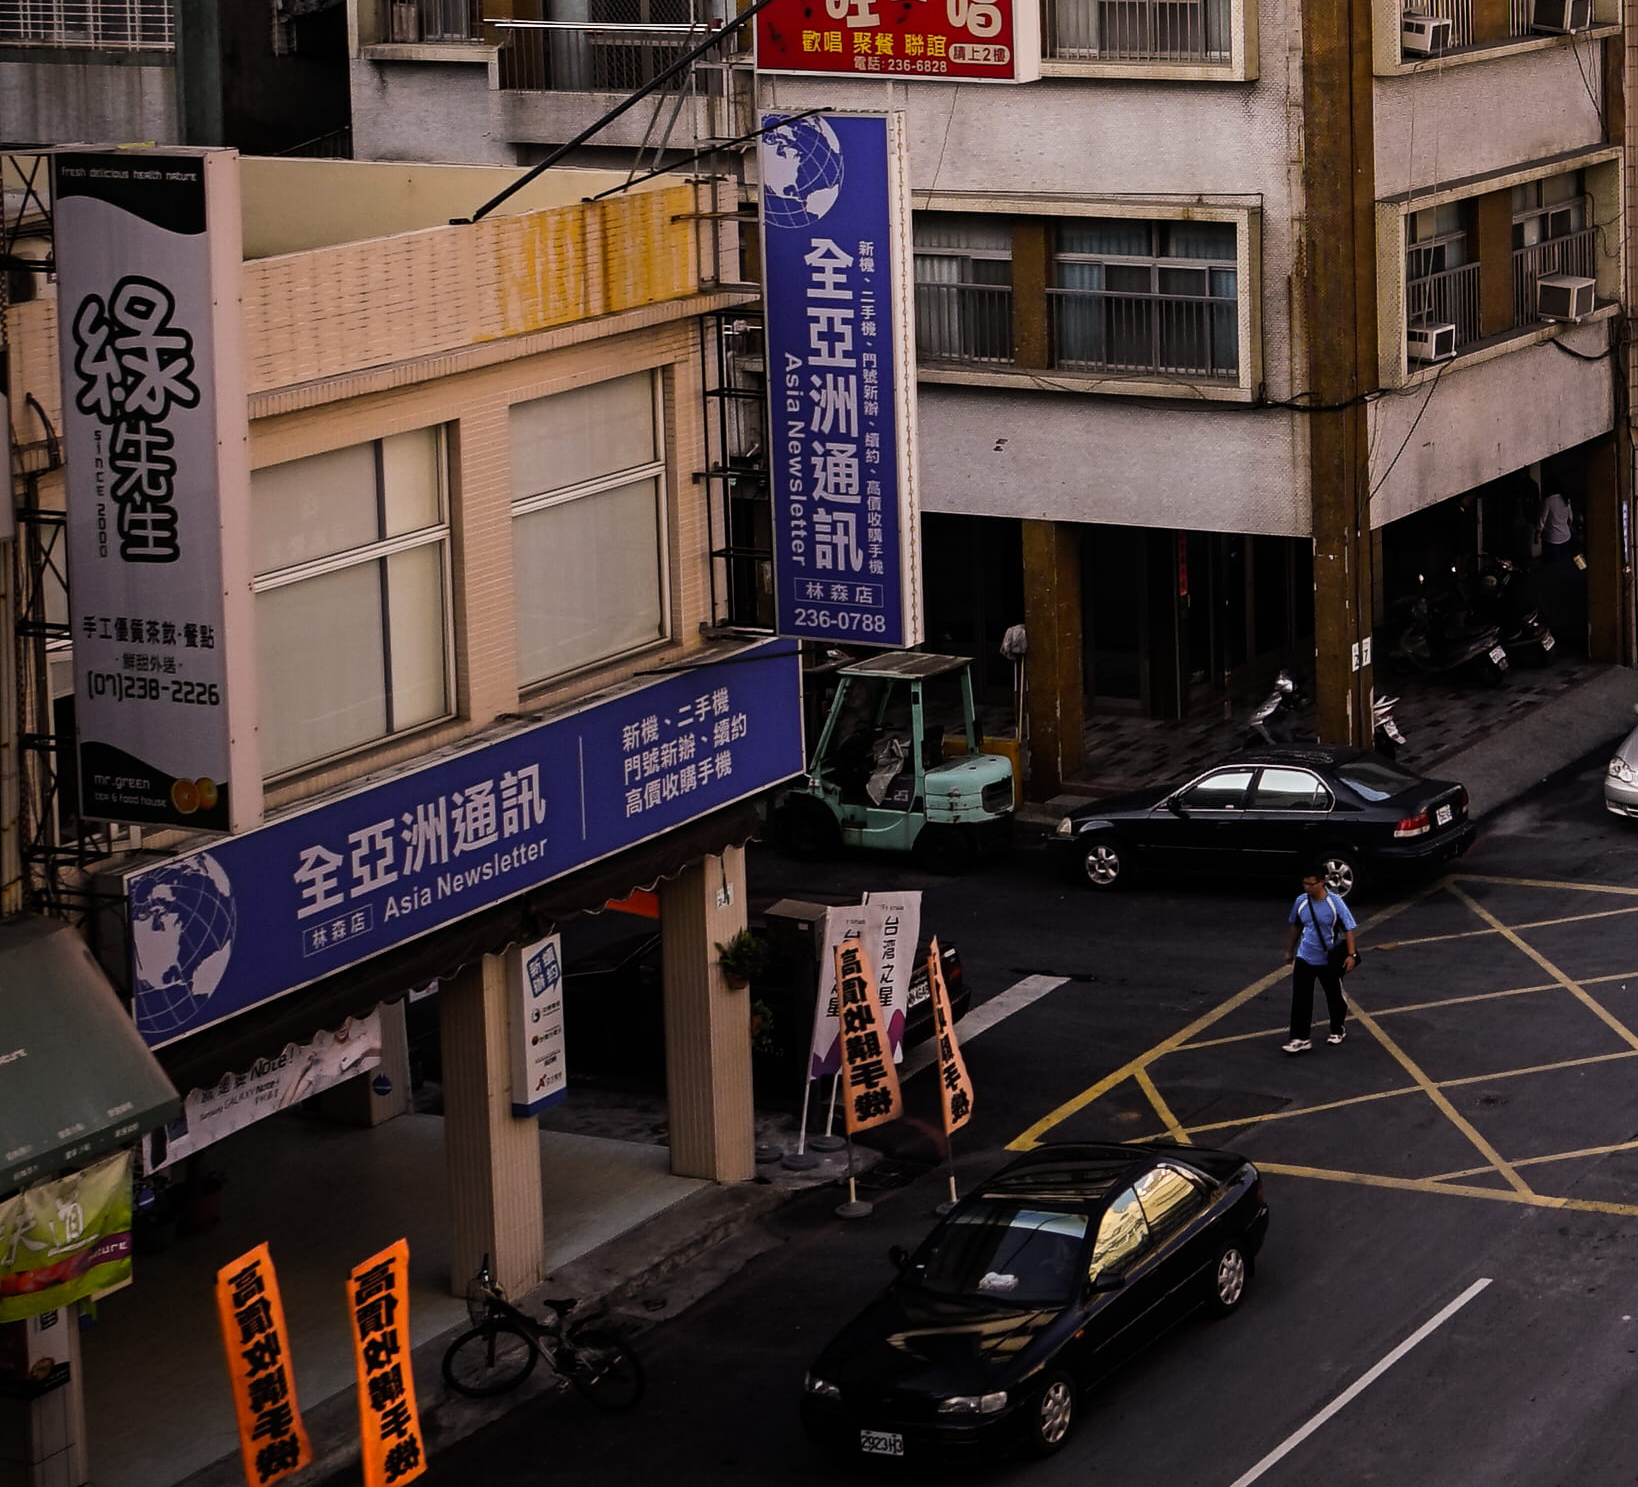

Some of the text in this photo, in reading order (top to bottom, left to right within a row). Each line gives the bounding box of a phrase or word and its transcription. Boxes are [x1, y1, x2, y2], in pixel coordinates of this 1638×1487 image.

[801, 29, 947, 58] 歡唱 聚餐 聯誼
[803, 237, 863, 574] 全亞洲通訊
[784, 352, 807, 568] Asia Newsletter
[794, 607, 886, 633] 236-0788
[805, 580, 873, 605] 林森店
[88, 670, 220, 706] (07)238-2226
[625, 749, 733, 818] 高價收購手機
[293, 762, 547, 920] 全亞洲通訊
[383, 836, 548, 923] Asia Newsletter
[311, 909, 366, 950] 林森店
[879, 915, 899, 1007] 台灣之星
